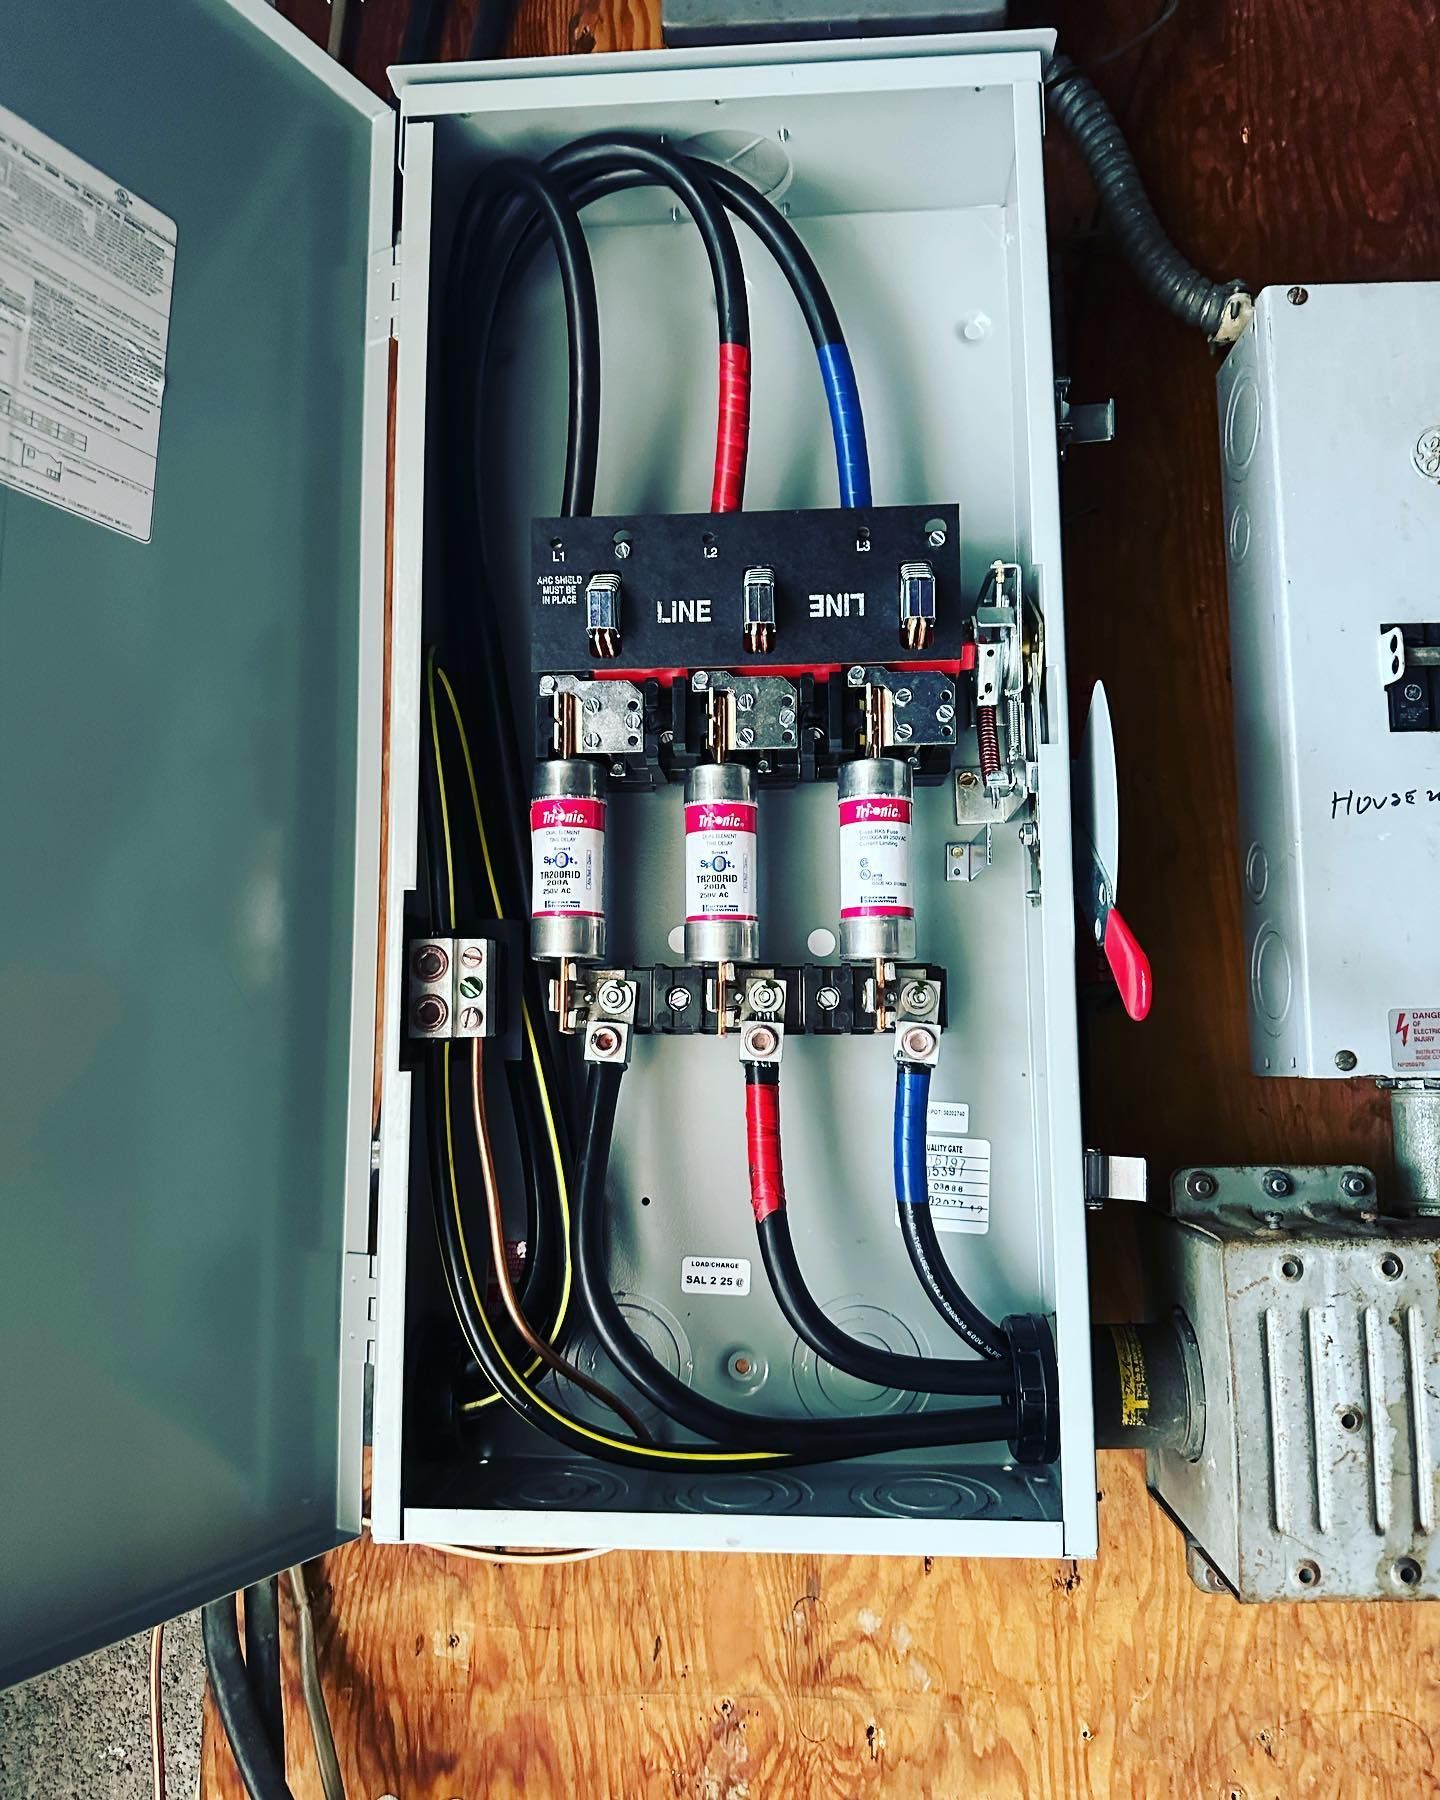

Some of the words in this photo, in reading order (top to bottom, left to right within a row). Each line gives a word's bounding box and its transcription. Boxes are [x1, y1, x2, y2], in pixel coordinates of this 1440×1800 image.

[857, 539, 871, 552] L3
[552, 550, 565, 563] L1
[704, 546, 718, 559] L2
[537, 575, 554, 586] ARC
[554, 575, 583, 586] SHIELD
[542, 585, 565, 595] MUST
[565, 585, 577, 595] BE
[542, 595, 551, 605] IN
[551, 595, 578, 605] PLACE
[808, 592, 865, 618] LINE
[656, 599, 712, 624] LINE
[1331, 789, 1418, 820] HOUSE
[926, 1143, 947, 1153] UALITY
[947, 1144, 963, 1154] GATE
[686, 1275, 707, 1285] SAL
[710, 1276, 717, 1285] 2
[720, 1276, 733, 1286] 25
[966, 1330, 984, 1345] 600V
